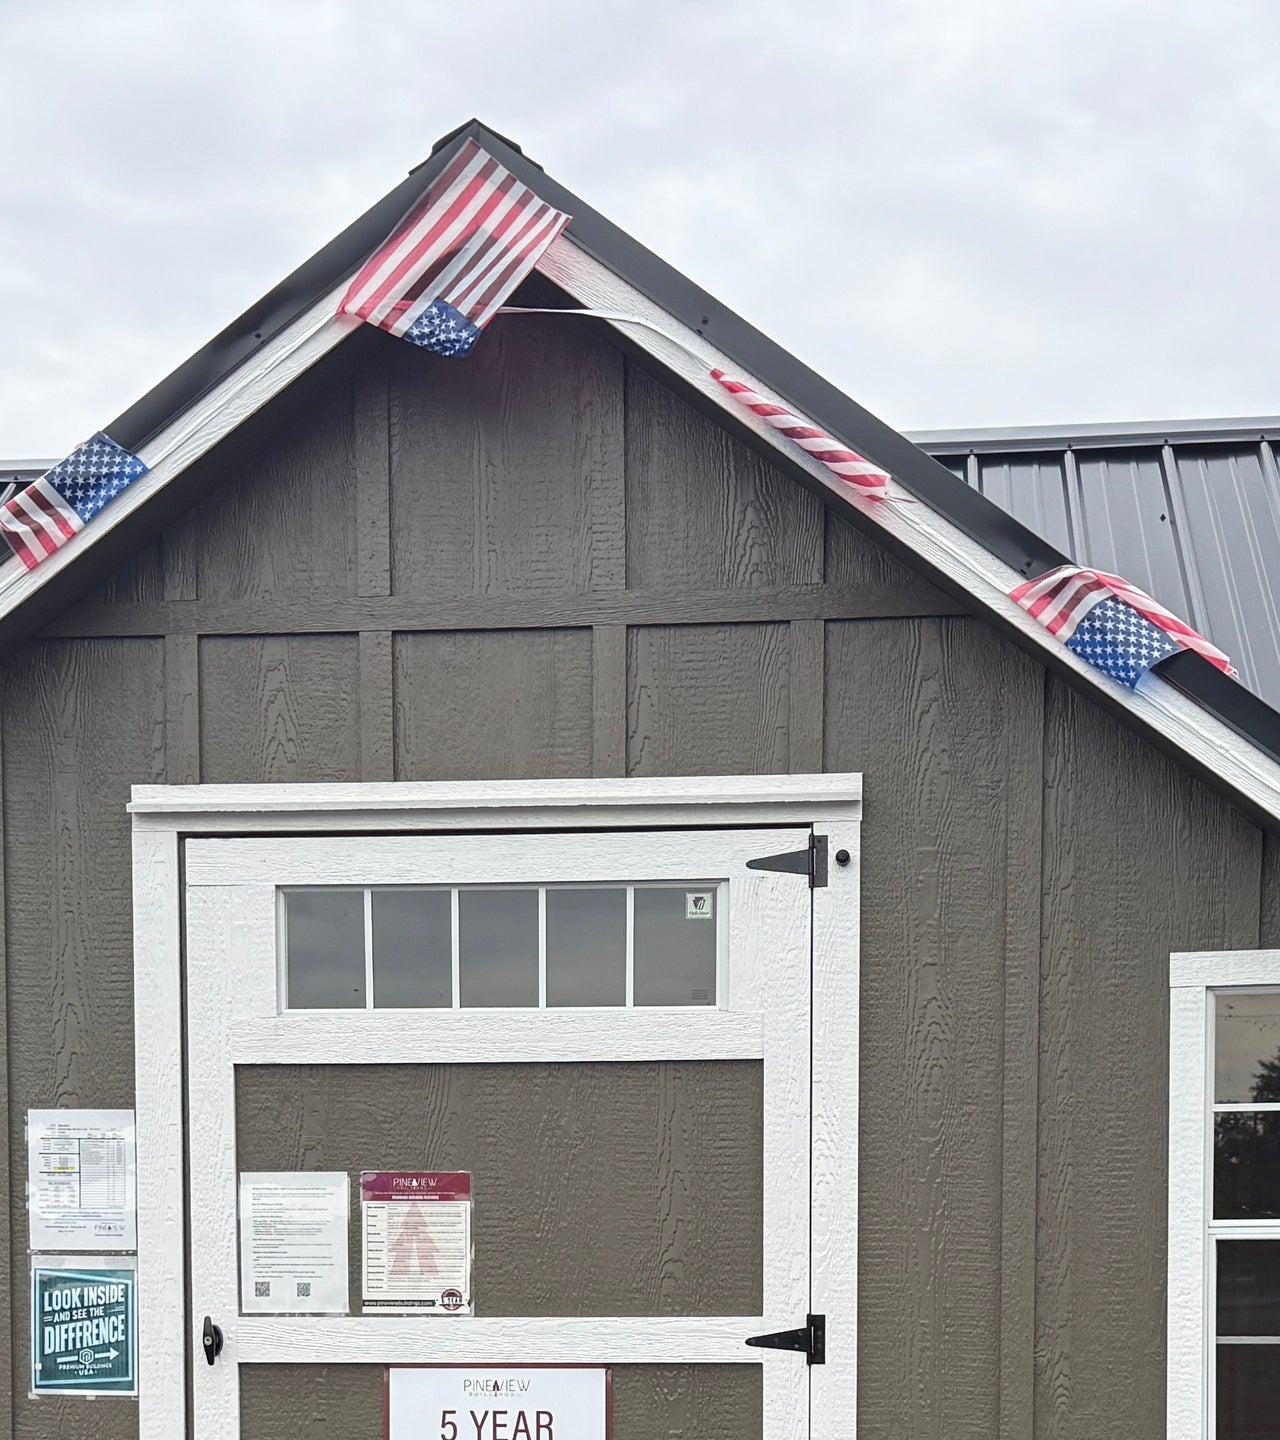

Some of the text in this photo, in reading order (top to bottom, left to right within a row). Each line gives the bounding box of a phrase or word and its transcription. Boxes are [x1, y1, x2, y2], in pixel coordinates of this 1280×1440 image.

[393, 1178, 438, 1187] PINEVIEW
[43, 1284, 126, 1312] LOOK INSIDE
[53, 1306, 105, 1323] AND SEE THE
[463, 1379, 531, 1392] PINEVIEW
